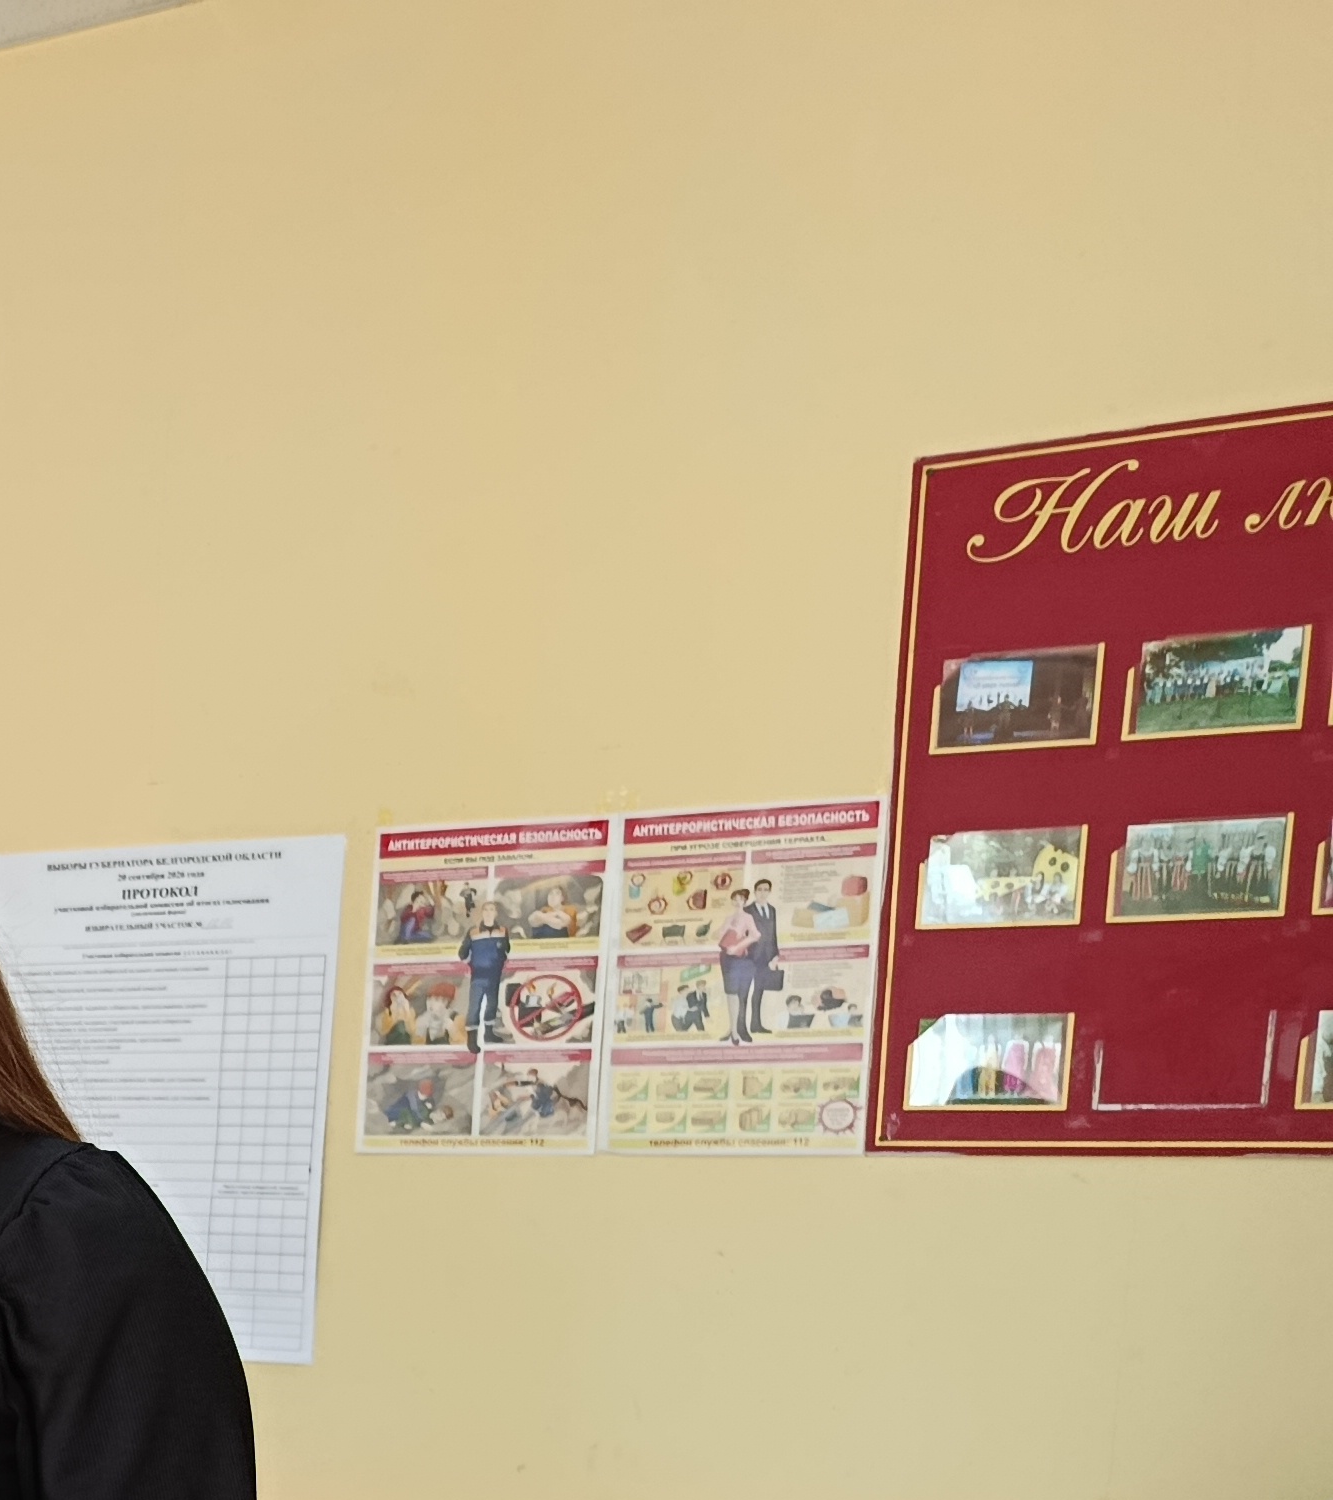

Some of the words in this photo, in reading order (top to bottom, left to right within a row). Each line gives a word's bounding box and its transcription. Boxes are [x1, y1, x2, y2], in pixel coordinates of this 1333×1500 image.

[966, 458, 1221, 563] Наш
[633, 817, 776, 837] АНТИТЕРРОРИСТИЧЕСКАЯ
[778, 809, 870, 827] БЕЗОПАСНОСТЬ
[387, 832, 517, 851] АНТИТЕРРОРИСТИЧЕСКАЯ
[518, 828, 603, 844] БЕЗОПАСНОСТЬ
[47, 862, 87, 872] ВЫБОРЫ
[88, 859, 154, 870] ГУБЕРНАТОРА
[155, 853, 233, 867] БЕЛГОРОДСКОЙ
[234, 851, 282, 862] ОБЛАСТИ
[128, 872, 165, 882] сентября
[186, 871, 205, 879] года
[122, 885, 199, 901] ПРОТОКОЛ
[85, 921, 154, 932] ИЗБИРАТЕЛЬНЫЙ
[155, 921, 195, 930] УЧАСТОК
